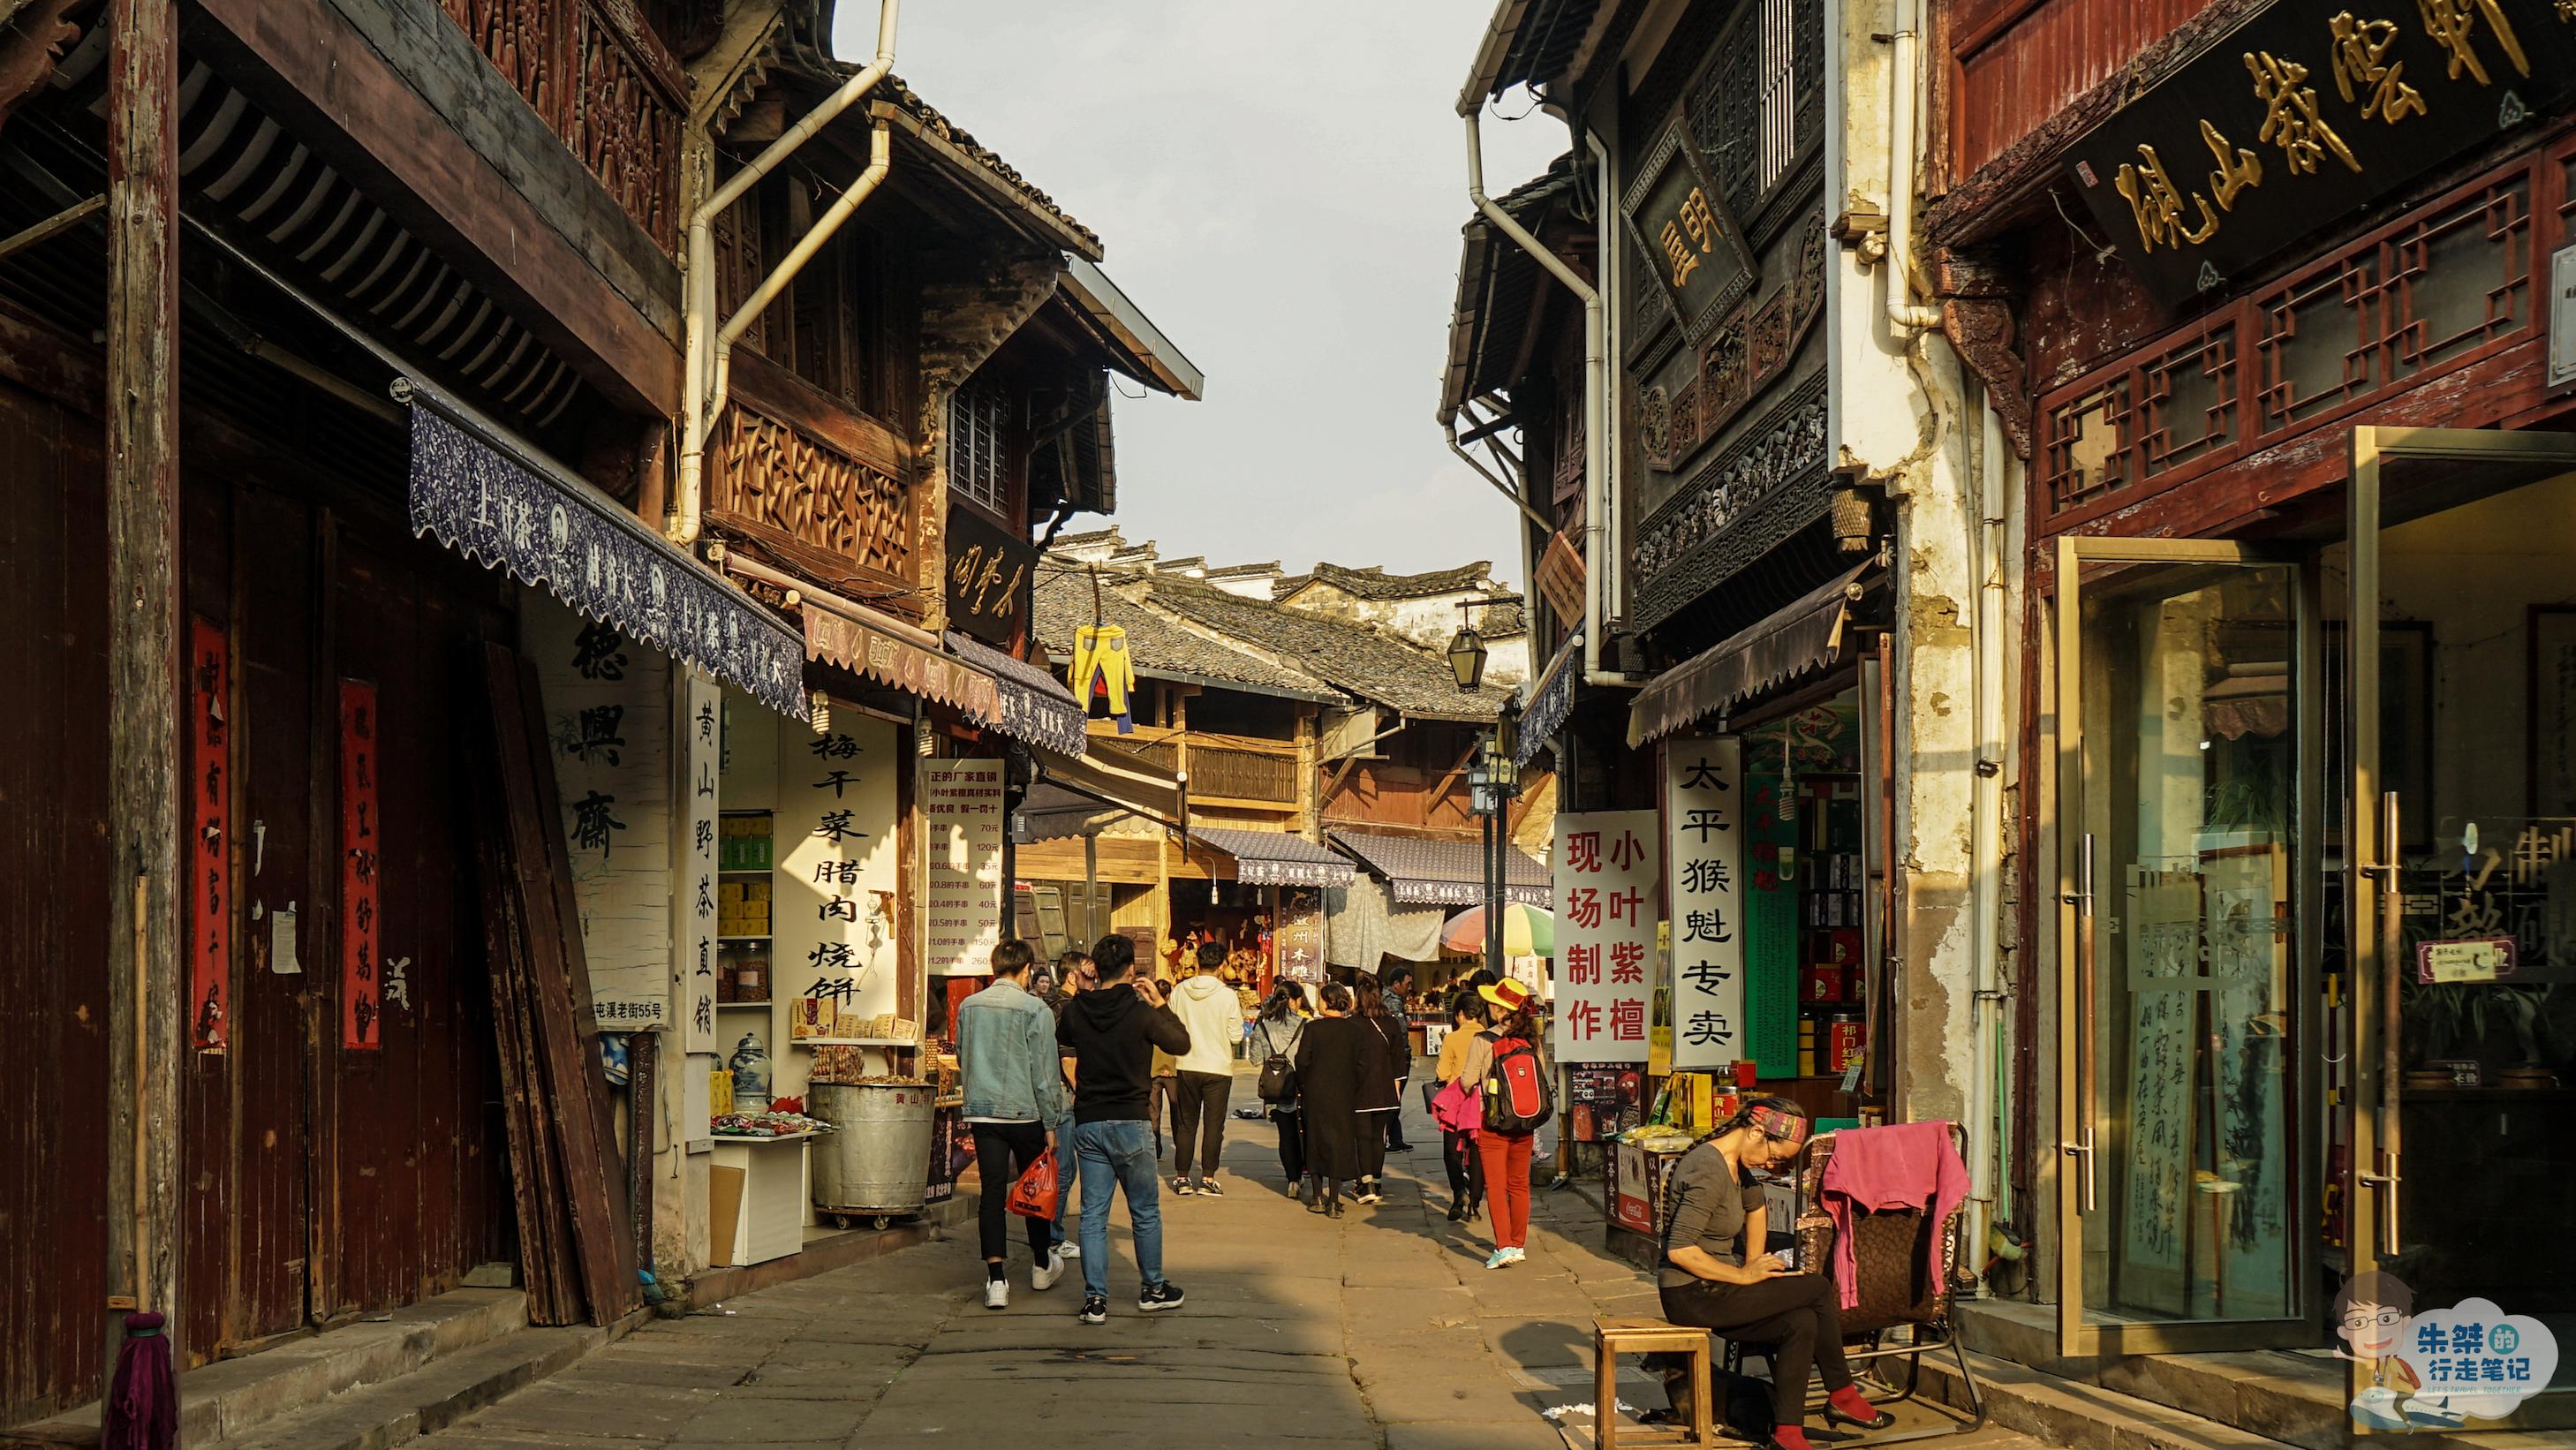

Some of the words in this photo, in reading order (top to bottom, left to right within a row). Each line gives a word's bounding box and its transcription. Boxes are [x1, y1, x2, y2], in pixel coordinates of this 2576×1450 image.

[804, 733, 869, 1006] 梅干菜腊肉烧饼
[930, 788, 1001, 797] 小叶紫檀真材实料
[961, 804, 998, 813] 假一罚十
[1568, 830, 1602, 1042] 现场制作
[1610, 828, 1645, 1042] 小叶紫檀
[1680, 757, 1733, 1046] 太平猴魁专卖
[594, 1001, 661, 1019] 屯溪老街55号
